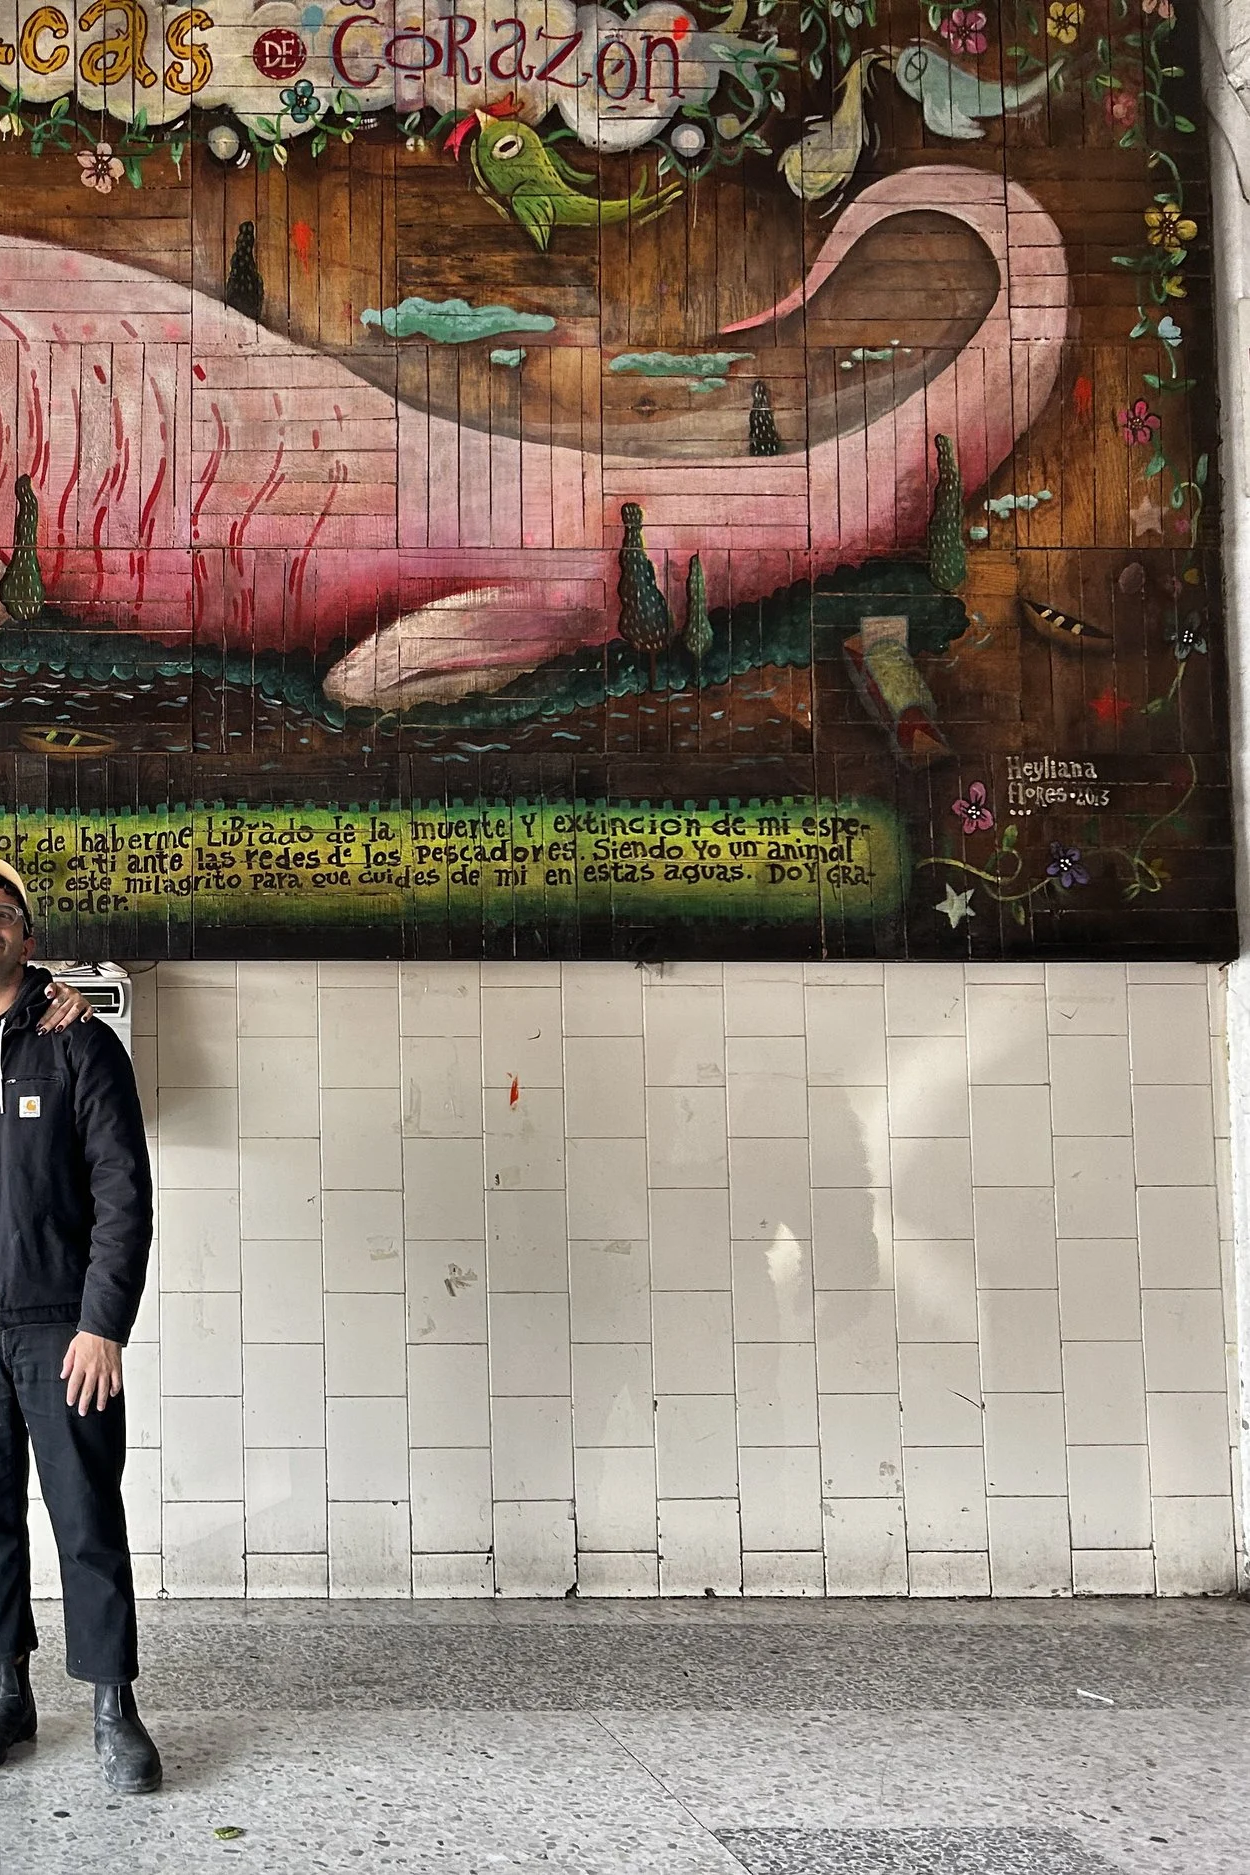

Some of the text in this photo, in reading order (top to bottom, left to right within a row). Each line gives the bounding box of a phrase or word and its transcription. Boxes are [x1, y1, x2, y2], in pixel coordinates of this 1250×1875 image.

[261, 38, 297, 68] DE
[37, 827, 66, 853] de
[80, 824, 192, 853] haberme
[326, 816, 357, 843] de
[368, 816, 396, 842] la
[408, 811, 506, 841] muerte
[712, 812, 746, 836] de
[756, 811, 791, 836] mi
[67, 854, 87, 871] a
[92, 851, 117, 874] ti
[127, 850, 184, 874] ante
[195, 846, 236, 871] las
[246, 846, 321, 870] redes
[327, 845, 352, 868] de
[362, 843, 402, 869] los
[593, 836, 684, 861] Siendo
[729, 840, 759, 860] un
[768, 836, 854, 863] animal
[66, 871, 111, 892] este
[125, 869, 242, 897] milagrito
[358, 864, 440, 889] cuides
[451, 864, 480, 886] de
[494, 865, 527, 887] mi
[546, 866, 572, 887] en
[584, 863, 654, 883] estas
[664, 863, 752, 885] aguas.
